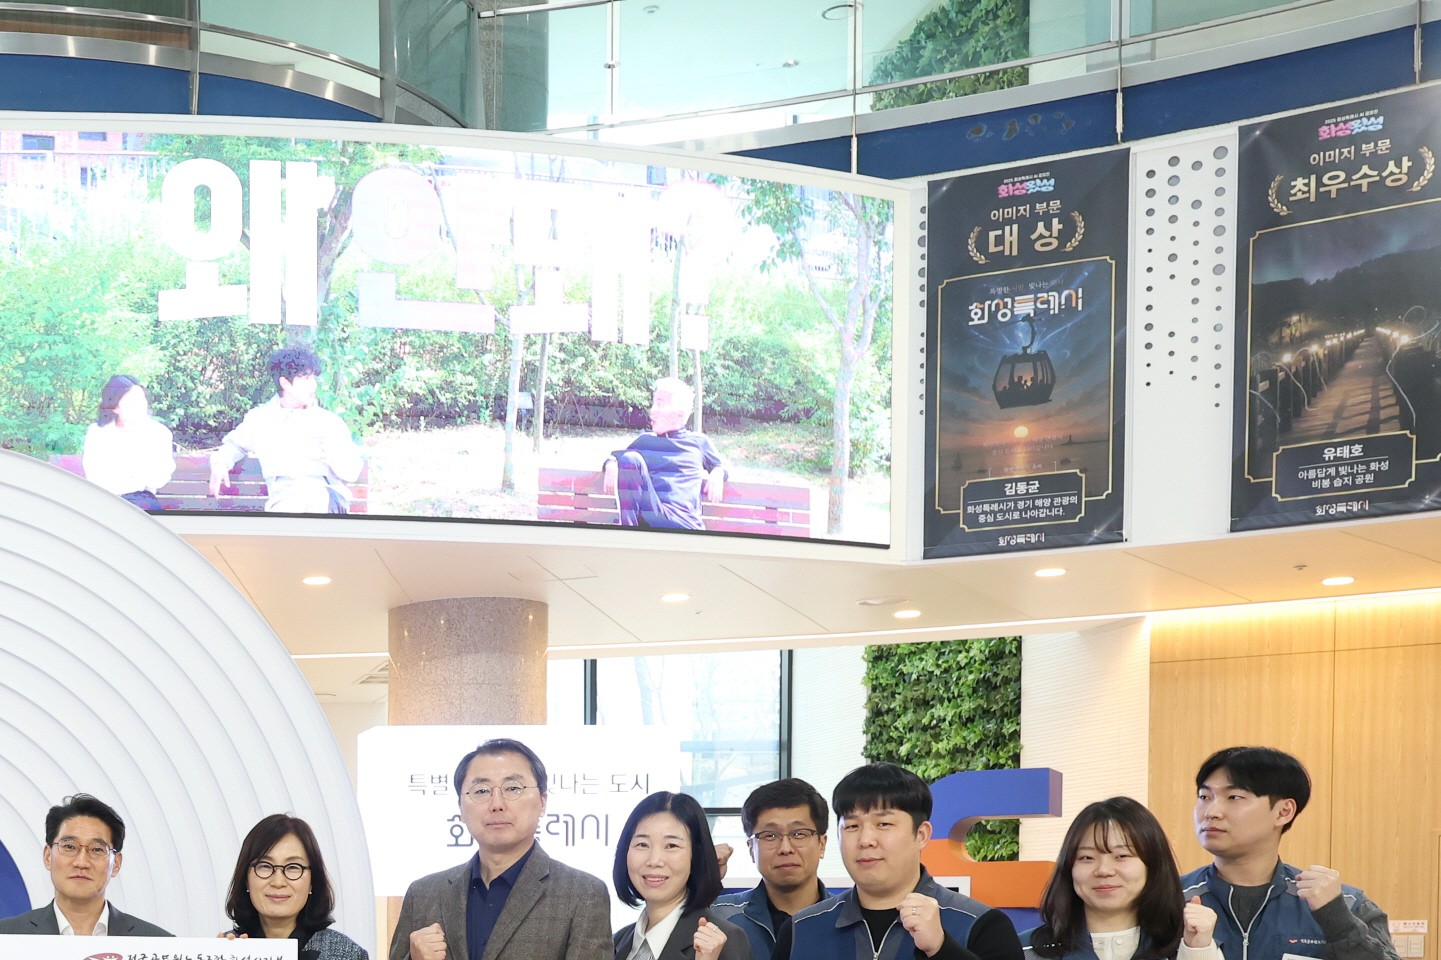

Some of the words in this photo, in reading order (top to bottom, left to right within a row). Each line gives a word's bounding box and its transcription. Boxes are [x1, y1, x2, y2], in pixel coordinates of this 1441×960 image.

[1310, 146, 1355, 166] 이미지
[1360, 139, 1392, 157] 부문
[1288, 156, 1413, 202] 최우수상
[991, 204, 1030, 222] 이미지
[1034, 200, 1062, 215] 부문
[988, 223, 1019, 256] 대
[1030, 217, 1063, 252] 상
[968, 287, 1083, 325] 화성특례시
[1322, 444, 1364, 461] 유태호
[1298, 466, 1336, 480] 아름답게
[1338, 463, 1367, 476] 빛나는
[1369, 460, 1389, 472] 화성
[1004, 480, 1040, 495] 김동균
[1312, 479, 1330, 489] 비봉
[1333, 476, 1352, 487] 습지
[1355, 473, 1374, 484] 공원
[967, 500, 1014, 514] 화성특례시가
[1017, 499, 1032, 510] 경기
[1034, 497, 1051, 508] 해양
[1053, 496, 1078, 506] 관광의
[1315, 500, 1369, 516] 화성특례시
[978, 513, 994, 523] 중심
[996, 511, 1020, 521] 도시로
[1022, 507, 1066, 519] 나아갑니다.
[998, 532, 1045, 547] 화성특례시
[609, 773, 650, 794] 도시
